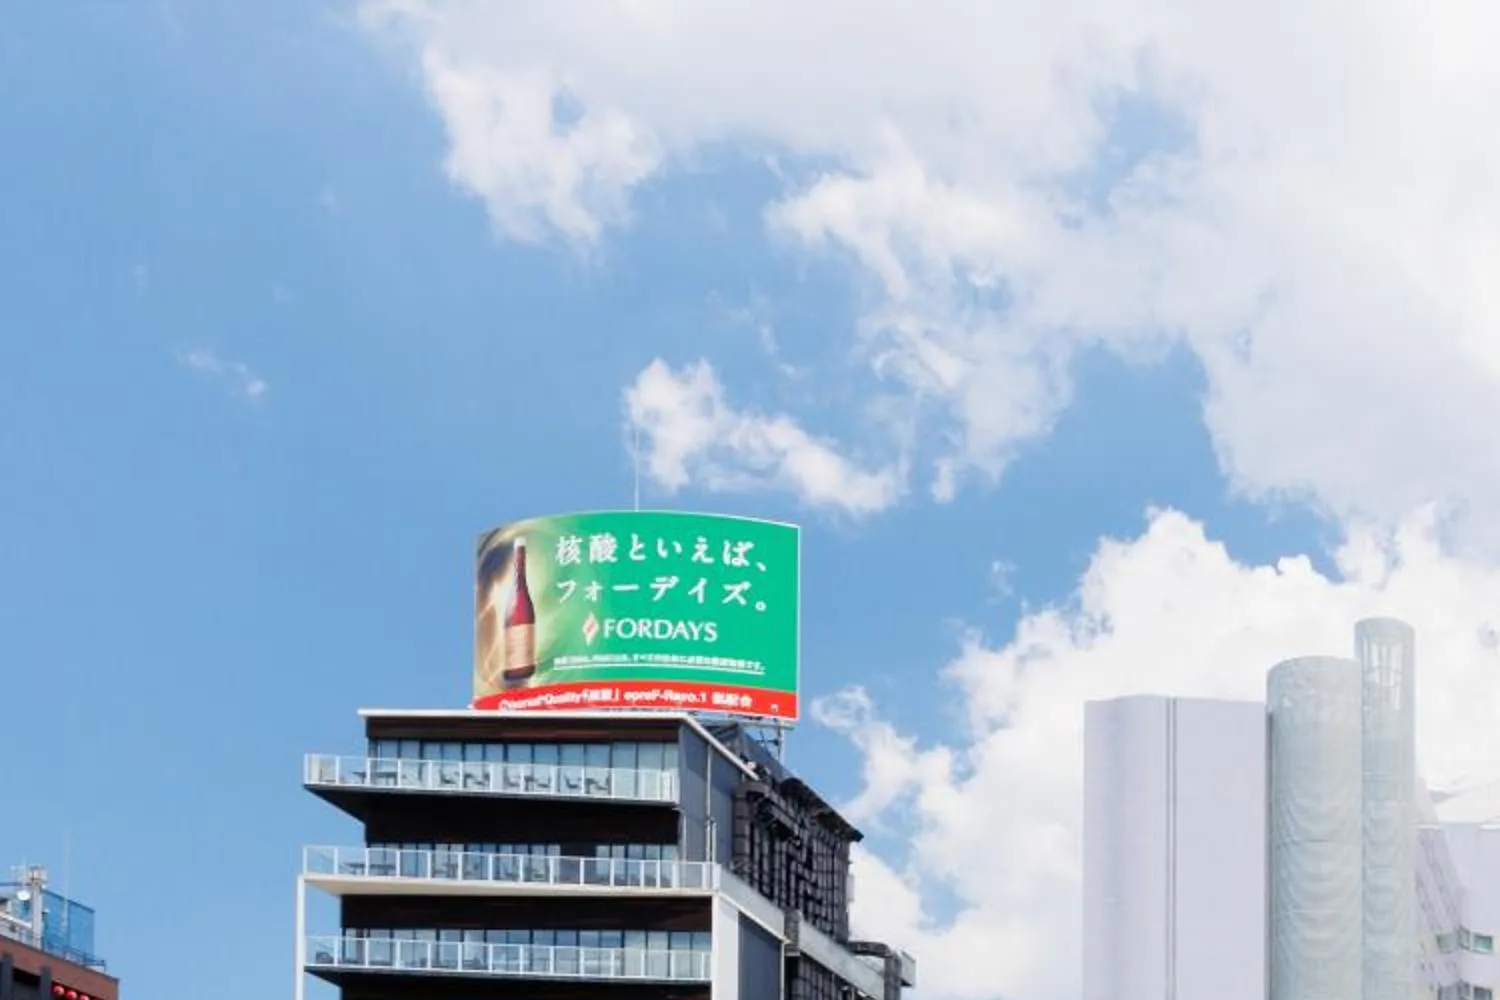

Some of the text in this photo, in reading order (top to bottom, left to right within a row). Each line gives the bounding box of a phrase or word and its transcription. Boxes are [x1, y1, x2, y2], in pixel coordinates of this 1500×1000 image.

[554, 533, 767, 573] 核酸といえば、
[556, 575, 767, 612] フォーデイズ。
[603, 617, 718, 642] FORDAYS
